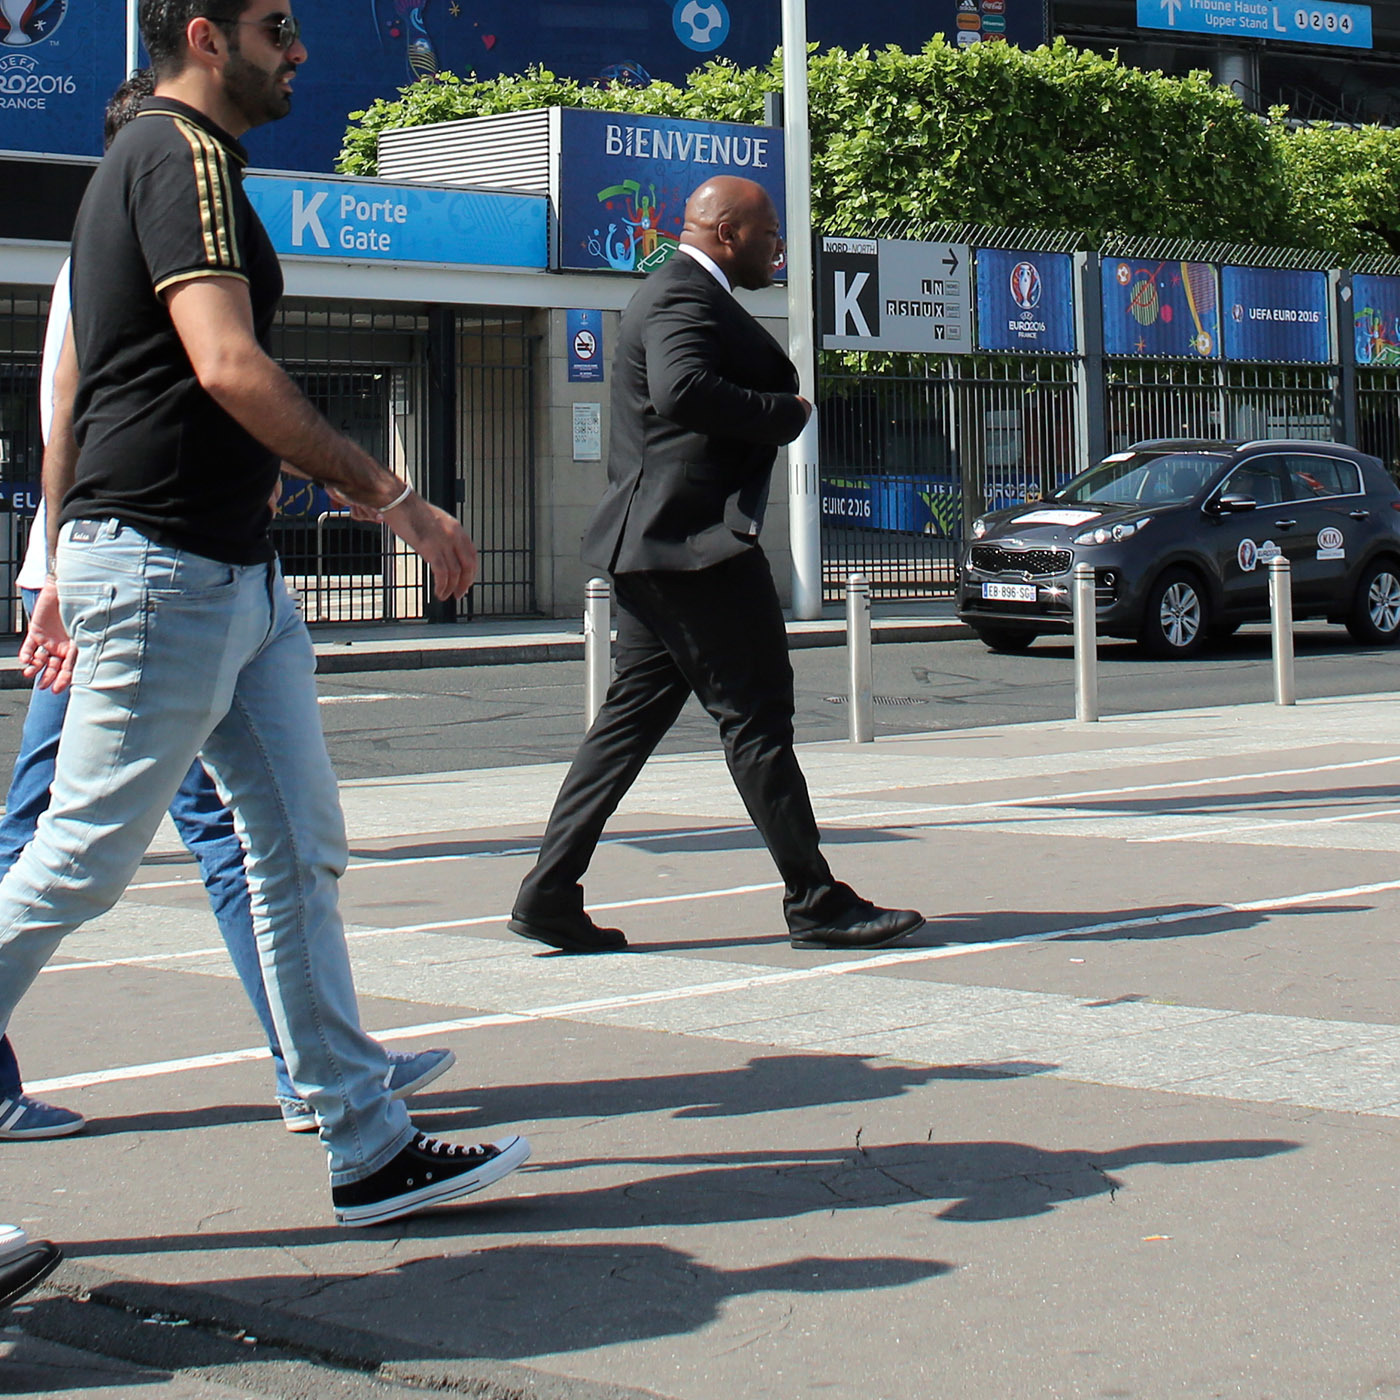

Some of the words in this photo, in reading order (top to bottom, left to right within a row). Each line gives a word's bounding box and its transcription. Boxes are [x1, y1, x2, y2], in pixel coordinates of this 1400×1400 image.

[1235, 2, 1268, 16] Haute
[1205, 13, 1236, 28] Upper
[1239, 17, 1268, 30] Stand
[1273, 7, 1287, 33] L
[1298, 14, 1306, 26] 1
[1313, 15, 1321, 28] 2
[1327, 17, 1335, 29] 3
[1341, 18, 1350, 30] 4
[606, 125, 769, 168] BIENVENUE
[291, 190, 331, 249] K
[340, 194, 408, 224] Porte
[340, 226, 391, 252] Gate
[834, 271, 872, 337] K
[1249, 308, 1272, 320] UEFA
[1273, 309, 1296, 321] EURO
[936, 327, 944, 340] Y
[1323, 533, 1338, 545] KIA
[989, 585, 1030, 599] EB-896-SG
